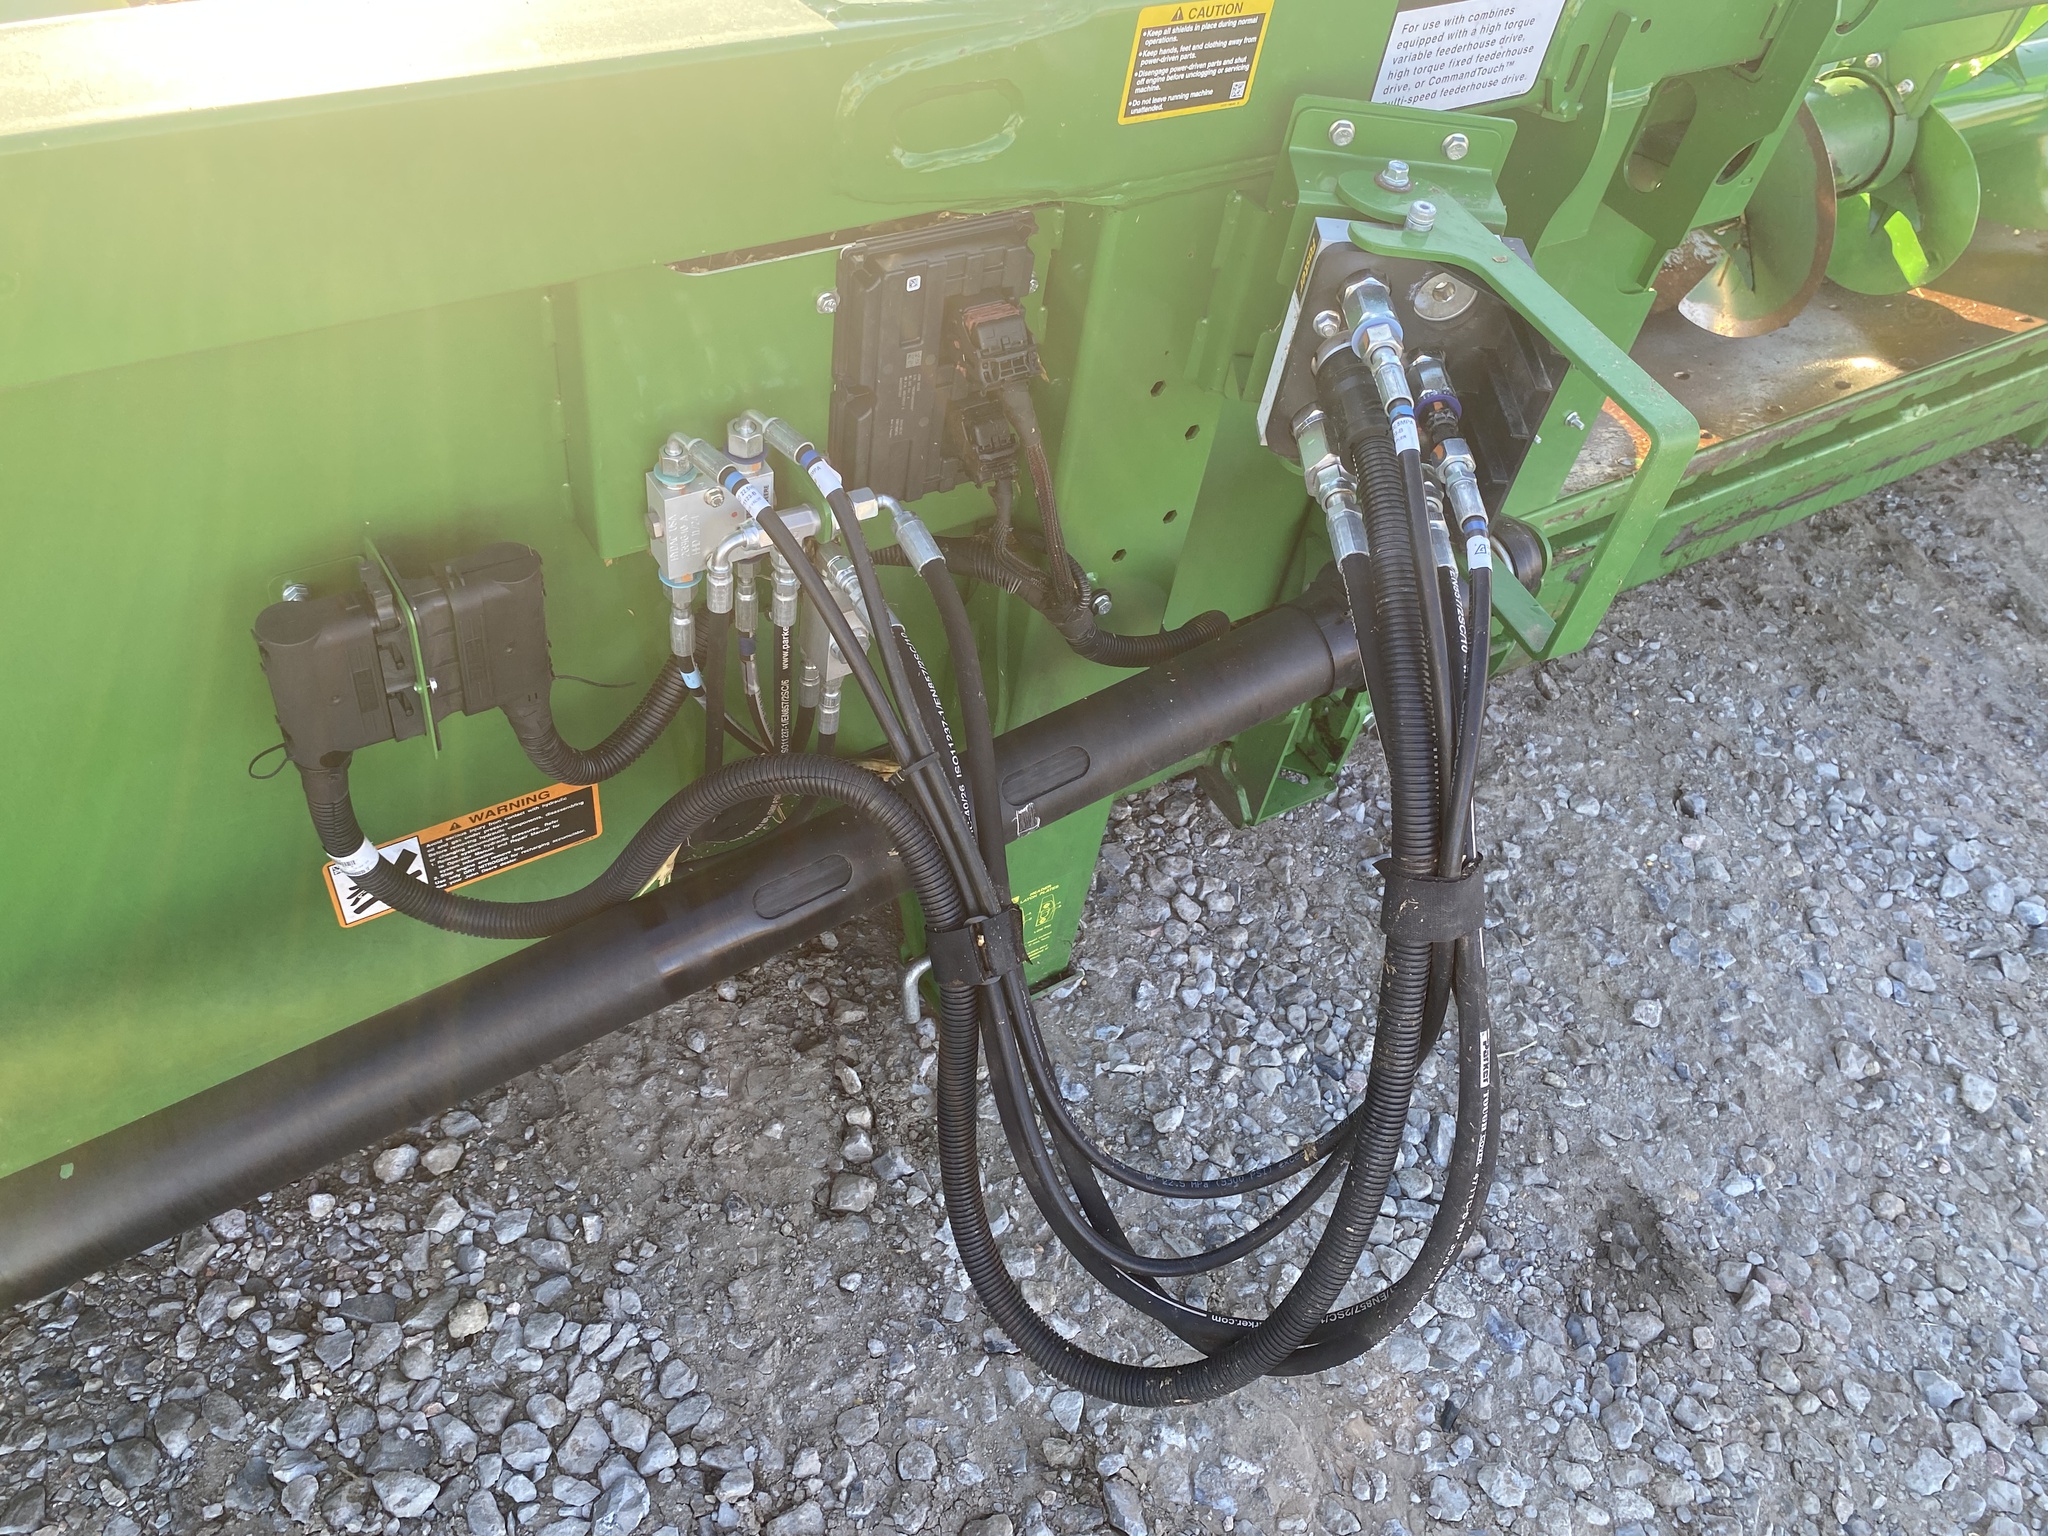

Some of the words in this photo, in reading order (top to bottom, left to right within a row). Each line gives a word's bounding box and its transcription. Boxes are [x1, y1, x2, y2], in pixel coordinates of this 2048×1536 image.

[1188, 2, 1244, 20] CAUTION
[1401, 23, 1420, 34] For
[1422, 20, 1441, 31] use
[1443, 14, 1465, 27] with
[1467, 7, 1516, 23] combines
[1147, 29, 1163, 38] Keep
[1163, 26, 1172, 35] all
[1172, 24, 1194, 34] shields
[1194, 23, 1201, 31] in
[1200, 22, 1218, 32] place
[1217, 19, 1238, 28] during
[1237, 16, 1259, 26] normal
[1396, 32, 1445, 50] equipped
[1447, 28, 1468, 41] with
[1470, 28, 1477, 36] a
[1479, 23, 1502, 36] high
[1503, 17, 1536, 31] torque
[1142, 49, 1158, 58] Keep
[1158, 46, 1179, 55] hands,
[1179, 43, 1192, 52] feet
[1191, 42, 1204, 51] and
[1203, 39, 1228, 49] clothing
[1228, 37, 1244, 47] away
[1243, 36, 1257, 44] from
[1144, 35, 1179, 47] operations.
[1392, 49, 1433, 65] variable
[1435, 38, 1497, 57] feederhouse
[1498, 33, 1526, 45] drive,
[1137, 67, 1170, 78] Disengage
[1169, 61, 1207, 74] power-driven
[1206, 59, 1222, 69] parts
[1222, 57, 1235, 66] and
[1233, 55, 1248, 64] shut
[1139, 55, 1180, 68] power-driven
[1179, 52, 1197, 61] parts.
[1387, 68, 1410, 81] high
[1413, 62, 1446, 75] torque
[1447, 55, 1474, 69] fixed
[1474, 44, 1535, 63] feederhouse
[1136, 77, 1146, 86] off
[1145, 76, 1166, 85] engine
[1166, 73, 1185, 82] before
[1185, 68, 1217, 78] unclogging
[1217, 67, 1224, 75] or
[1224, 63, 1250, 73] servicing
[1440, 79, 1499, 97] feederhouse
[1501, 73, 1527, 85] drive.
[1132, 99, 1141, 107] Do
[1141, 97, 1152, 106] not
[1151, 96, 1168, 104] leave
[1167, 92, 1190, 101] running
[1189, 88, 1214, 98] machine
[1134, 84, 1161, 94] machine.
[1382, 82, 1411, 95] drive,
[1414, 80, 1426, 89] or
[1130, 103, 1164, 115] unattended.
[667, 513, 678, 532] USA
[468, 790, 550, 824] WARNING
[426, 839, 443, 848] Avoid
[445, 831, 467, 841] serious
[469, 825, 486, 834] injury
[488, 819, 502, 827] from
[504, 811, 525, 821] contact
[541, 796, 568, 808] hydraulic
[428, 849, 448, 858] Before
[450, 839, 477, 850] removing
[479, 828, 505, 839] hydraulic
[545, 801, 585, 817] disassembling
[464, 832, 481, 840] under
[483, 822, 509, 834] pressure.
[446, 855, 472, 866] Operator
[474, 847, 495, 856] Manual
[510, 834, 528, 844] Repair
[530, 827, 551, 836] Manual
[460, 847, 481, 856] system
[483, 836, 509, 848] hydraulic
[544, 819, 559, 827] Refer
[438, 848, 466, 859] changing
[456, 863, 476, 872] engine
[490, 850, 512, 860] remove
[478, 856, 509, 869] NITROGEN
[520, 841, 551, 854] recharging
[439, 864, 460, 874] system
[449, 877, 463, 886] your
[464, 872, 479, 880] John
[481, 865, 498, 874] Deere
[1162, 1178, 1186, 1188] 22.5
[1190, 1181, 1209, 1189] MPa
[1250, 1165, 1273, 1180] PSI)
